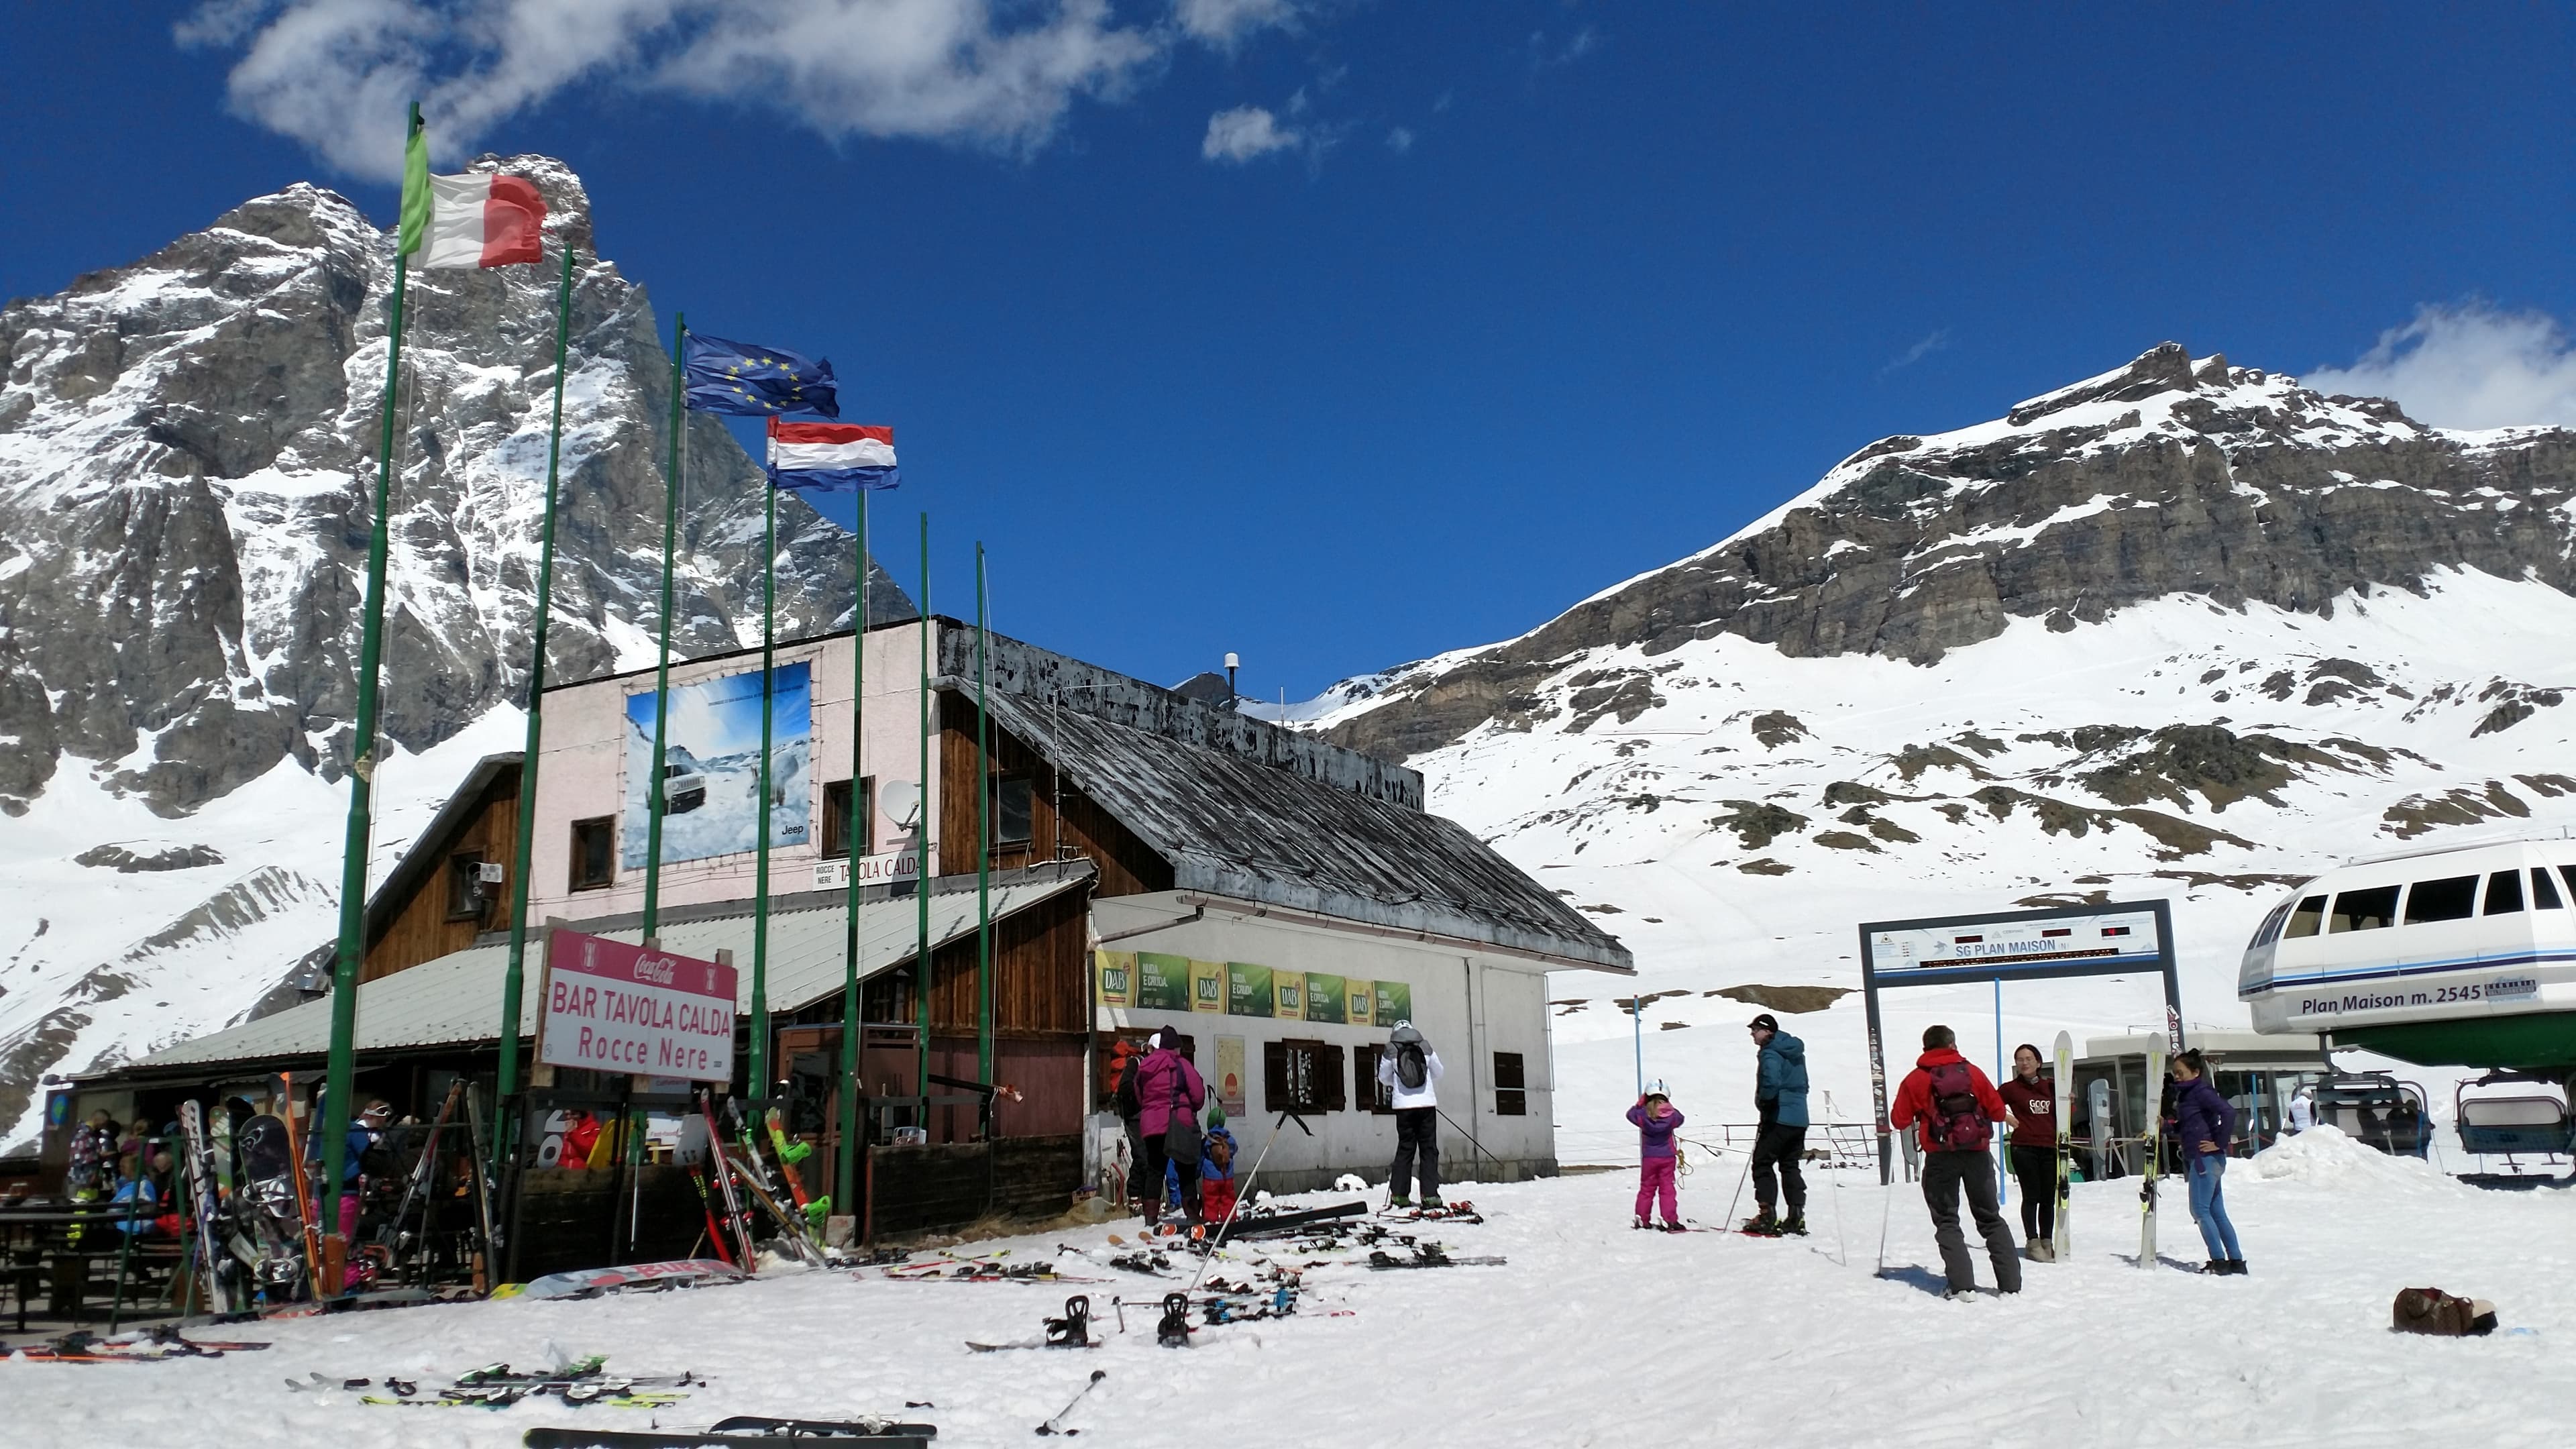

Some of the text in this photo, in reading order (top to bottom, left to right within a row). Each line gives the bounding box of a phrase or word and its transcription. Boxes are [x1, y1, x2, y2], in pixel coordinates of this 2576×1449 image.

[782, 825, 804, 835] Jeep
[816, 865, 835, 875] ROCCE
[840, 861, 880, 881] TAOLA
[818, 875, 832, 884] NERE
[1955, 946, 1972, 957] SG
[1975, 943, 2004, 956] PLAN
[2008, 939, 2056, 954] MAISON
[1105, 970, 1126, 990] DAB
[1199, 979, 1217, 998] DAB
[1281, 987, 1297, 1005] DAB
[1352, 996, 1367, 1012] DAB
[2302, 998, 2338, 1014] Plan
[2343, 993, 2404, 1011] Maison
[2411, 994, 2433, 1005] m.
[2436, 984, 2481, 1002] 2545
[552, 981, 731, 1038] BAR TAVOLA CALDA
[578, 1026, 707, 1070] Rocce Nere
